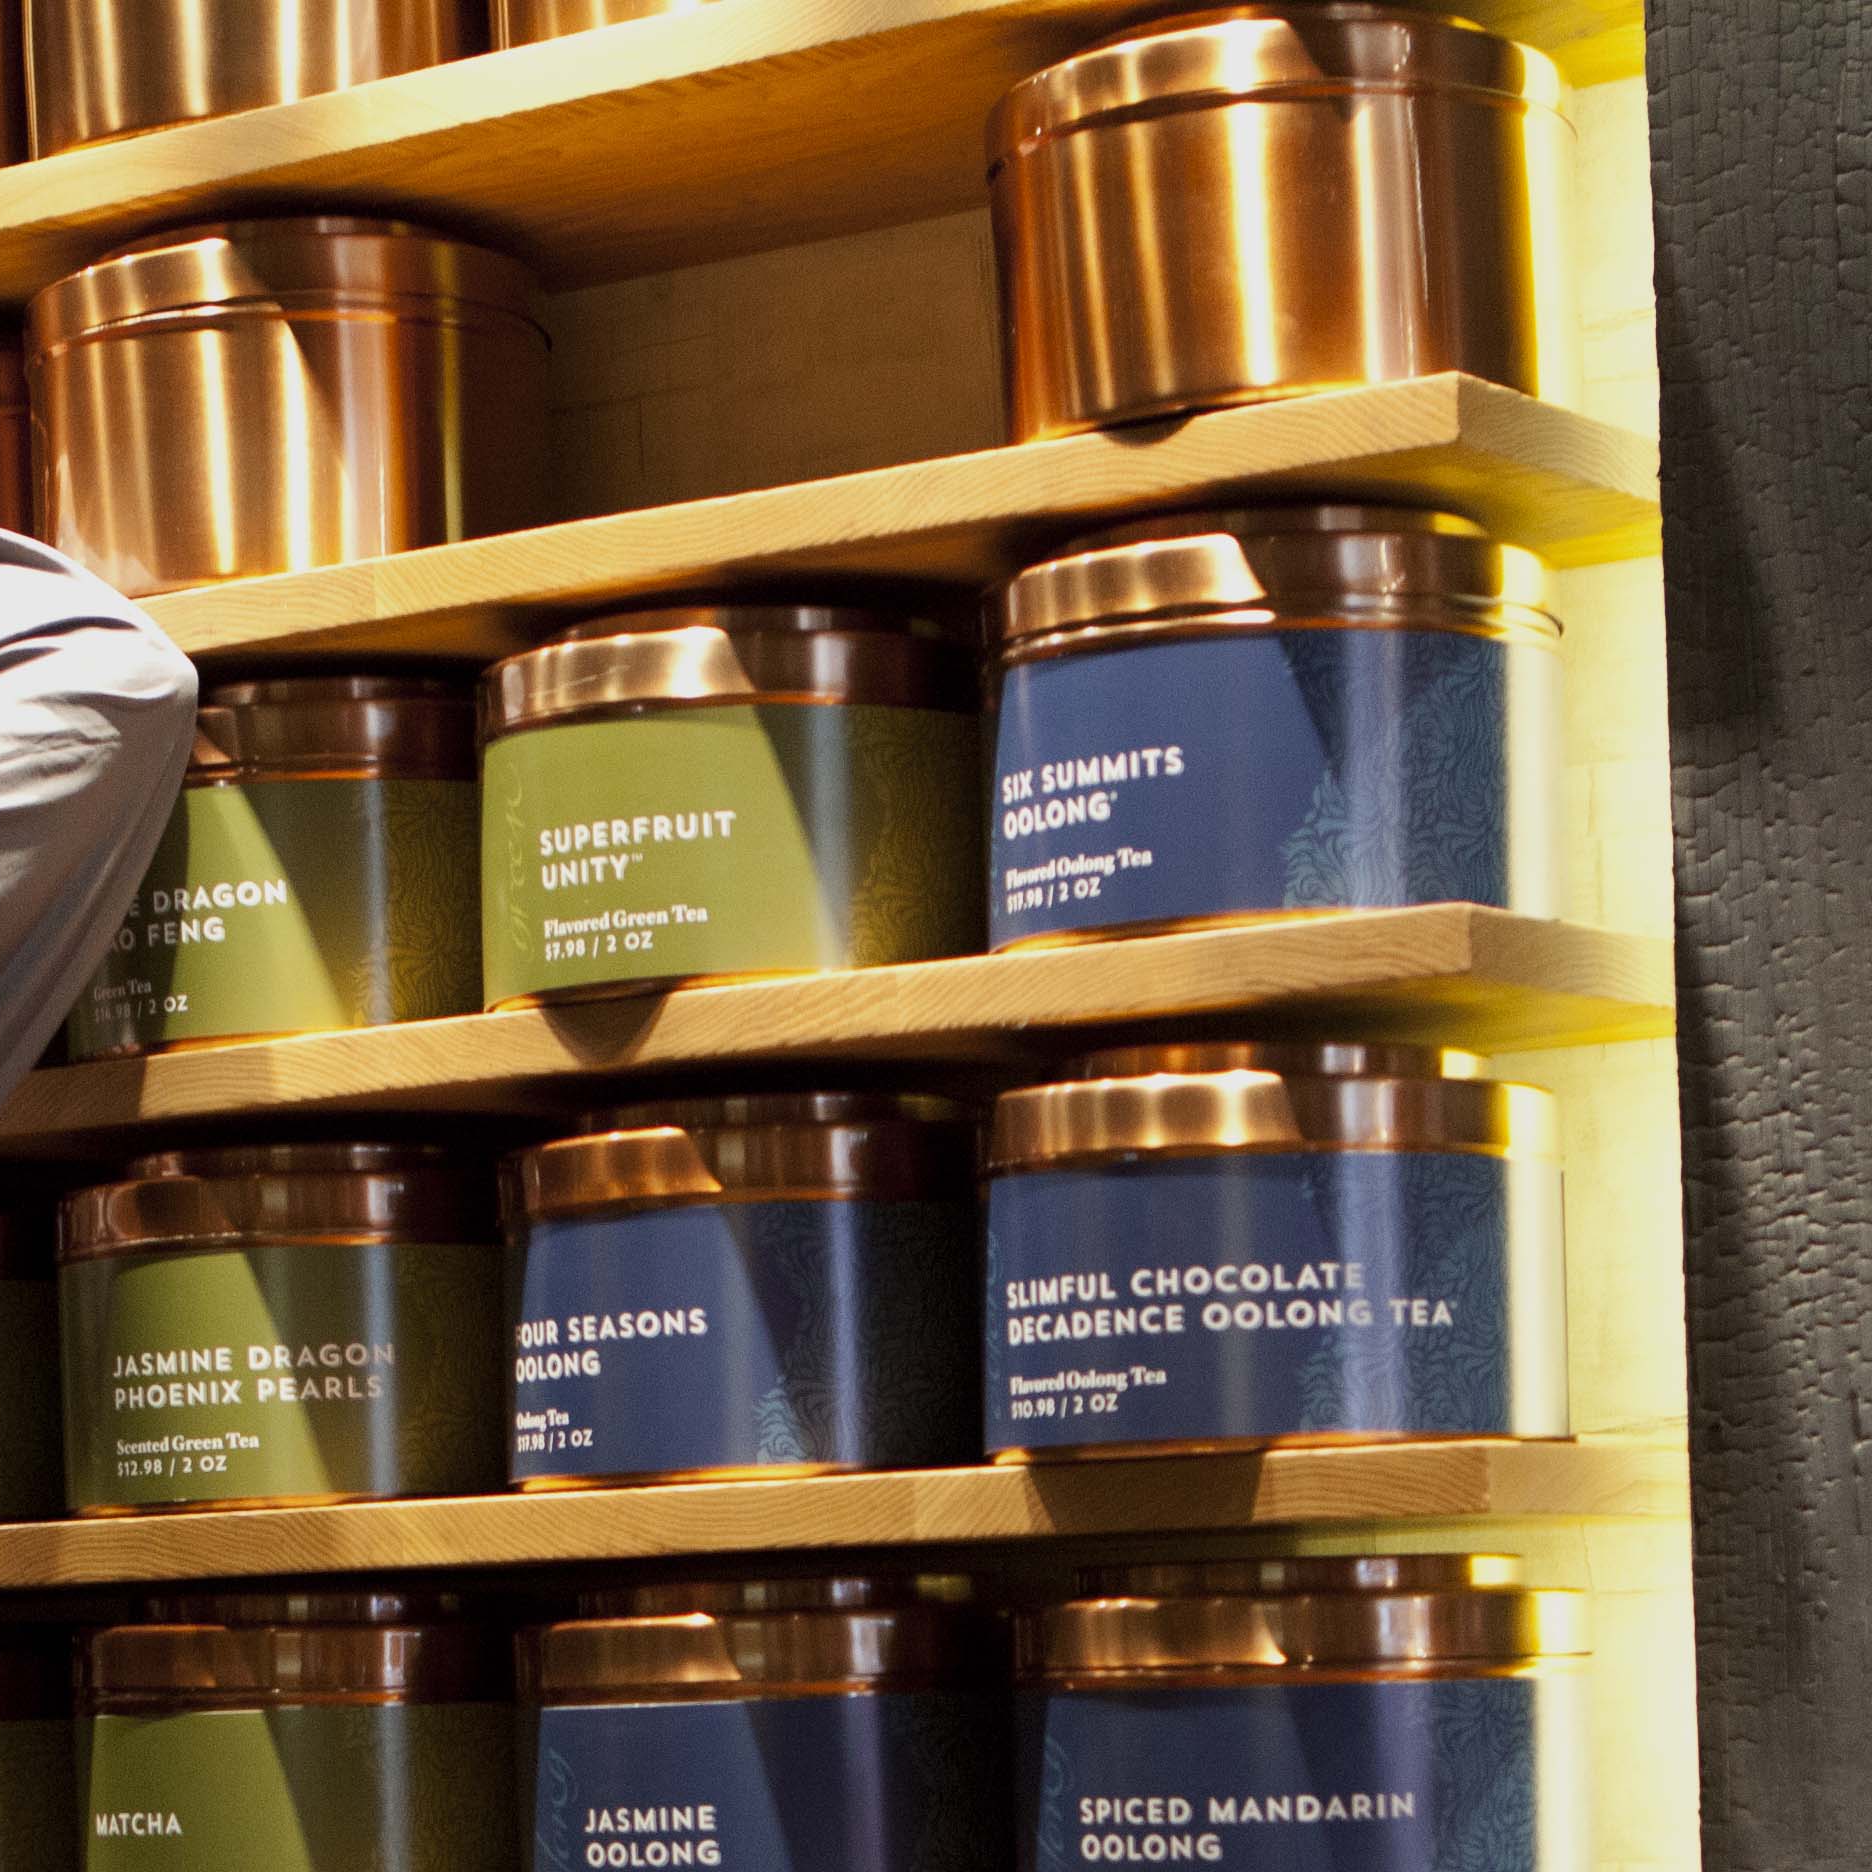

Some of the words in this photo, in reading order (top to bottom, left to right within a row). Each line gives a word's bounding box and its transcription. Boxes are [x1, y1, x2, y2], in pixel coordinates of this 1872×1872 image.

[1001, 769, 1033, 805] SIX
[1040, 745, 1184, 794] SUMMITS
[540, 809, 736, 858] SUPERFRUIT
[1056, 854, 1116, 880] Oolong
[1116, 846, 1153, 868] Tea
[154, 880, 288, 913] DRAGON
[148, 916, 225, 948] FENG
[544, 909, 609, 939] Flavored
[612, 907, 668, 929] Green
[668, 904, 708, 924] Tea
[546, 936, 585, 962] $7.98
[606, 935, 616, 953] 2
[624, 930, 653, 952] OZ
[129, 978, 152, 996] Tea
[1007, 1274, 1118, 1310] SLIMFUL
[1130, 1261, 1369, 1299] CHOCOLATE
[568, 1306, 709, 1344] SEASONS
[1007, 1303, 1186, 1346] DECADENCE
[1201, 1299, 1374, 1332] OOLONG
[113, 1346, 232, 1378] JASMINE
[248, 1343, 394, 1371] DRAGON
[515, 1349, 602, 1384] OOLONG
[114, 1380, 242, 1410] PHOENIX
[257, 1375, 384, 1404] PEARLS
[1010, 1373, 1066, 1396] Flavored
[1067, 1370, 1128, 1392] Oolong
[1128, 1366, 1167, 1386] Tea
[547, 1408, 569, 1426] Tea
[116, 1436, 170, 1455] Scented
[172, 1435, 224, 1452] Green
[225, 1432, 260, 1450] Tea
[117, 1458, 162, 1477] $12.98
[182, 1456, 192, 1474] 2
[201, 1455, 228, 1472] OZ
[95, 1812, 183, 1838] MATCHA
[584, 1804, 716, 1834] JASMINE
[1078, 1797, 1193, 1826] SPICED
[1208, 1792, 1416, 1824] MANDARIN
[585, 1839, 722, 1868] OOLONG
[1080, 1833, 1223, 1862] OOLONG
